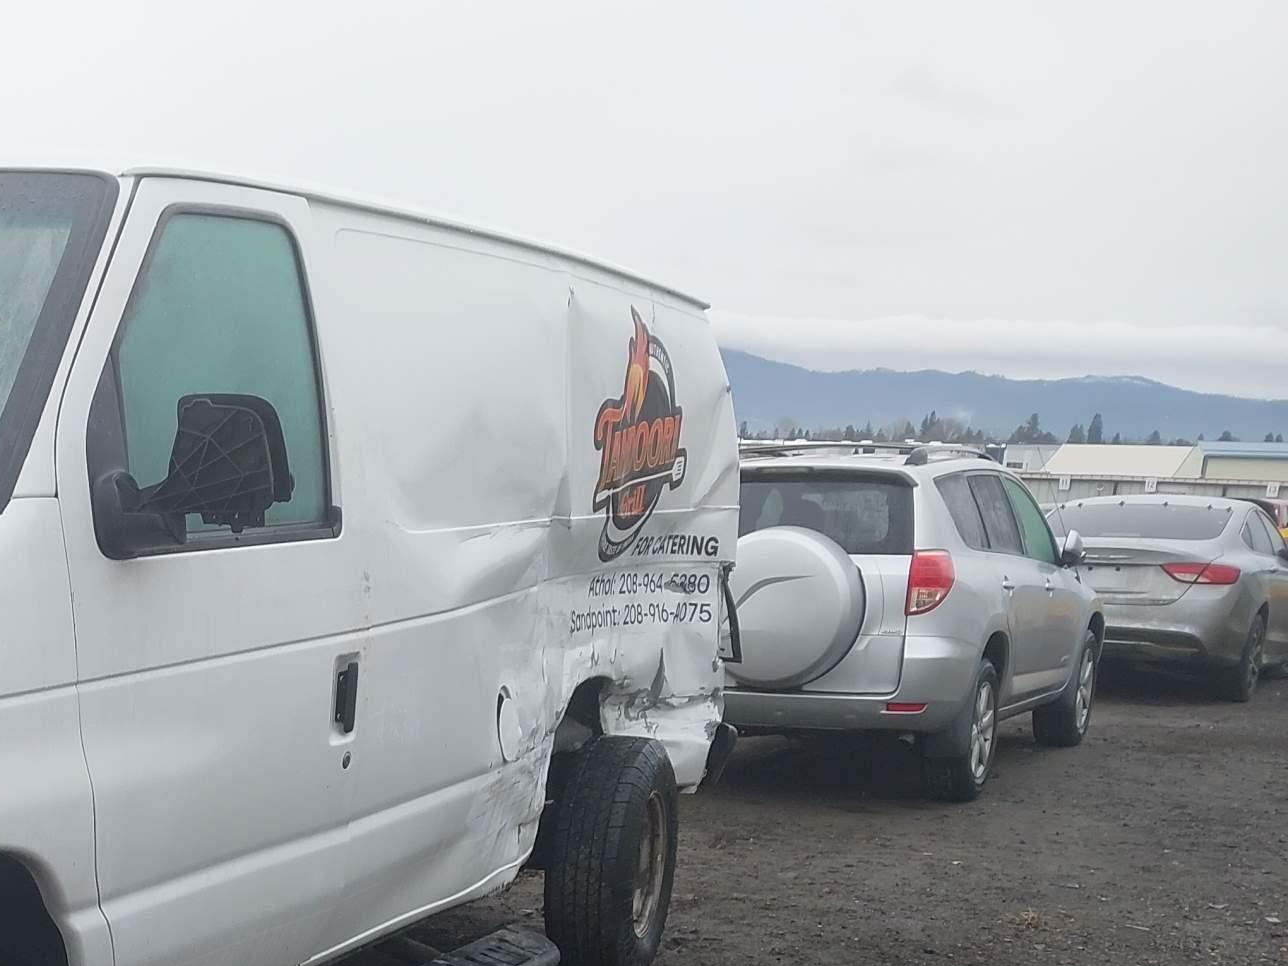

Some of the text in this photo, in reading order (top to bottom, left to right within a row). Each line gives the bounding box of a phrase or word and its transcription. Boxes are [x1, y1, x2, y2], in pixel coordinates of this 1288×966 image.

[631, 535, 653, 556] FOR
[652, 534, 720, 557] CATERING
[588, 572, 616, 597] Athol:
[570, 602, 621, 637] Sandpoint:
